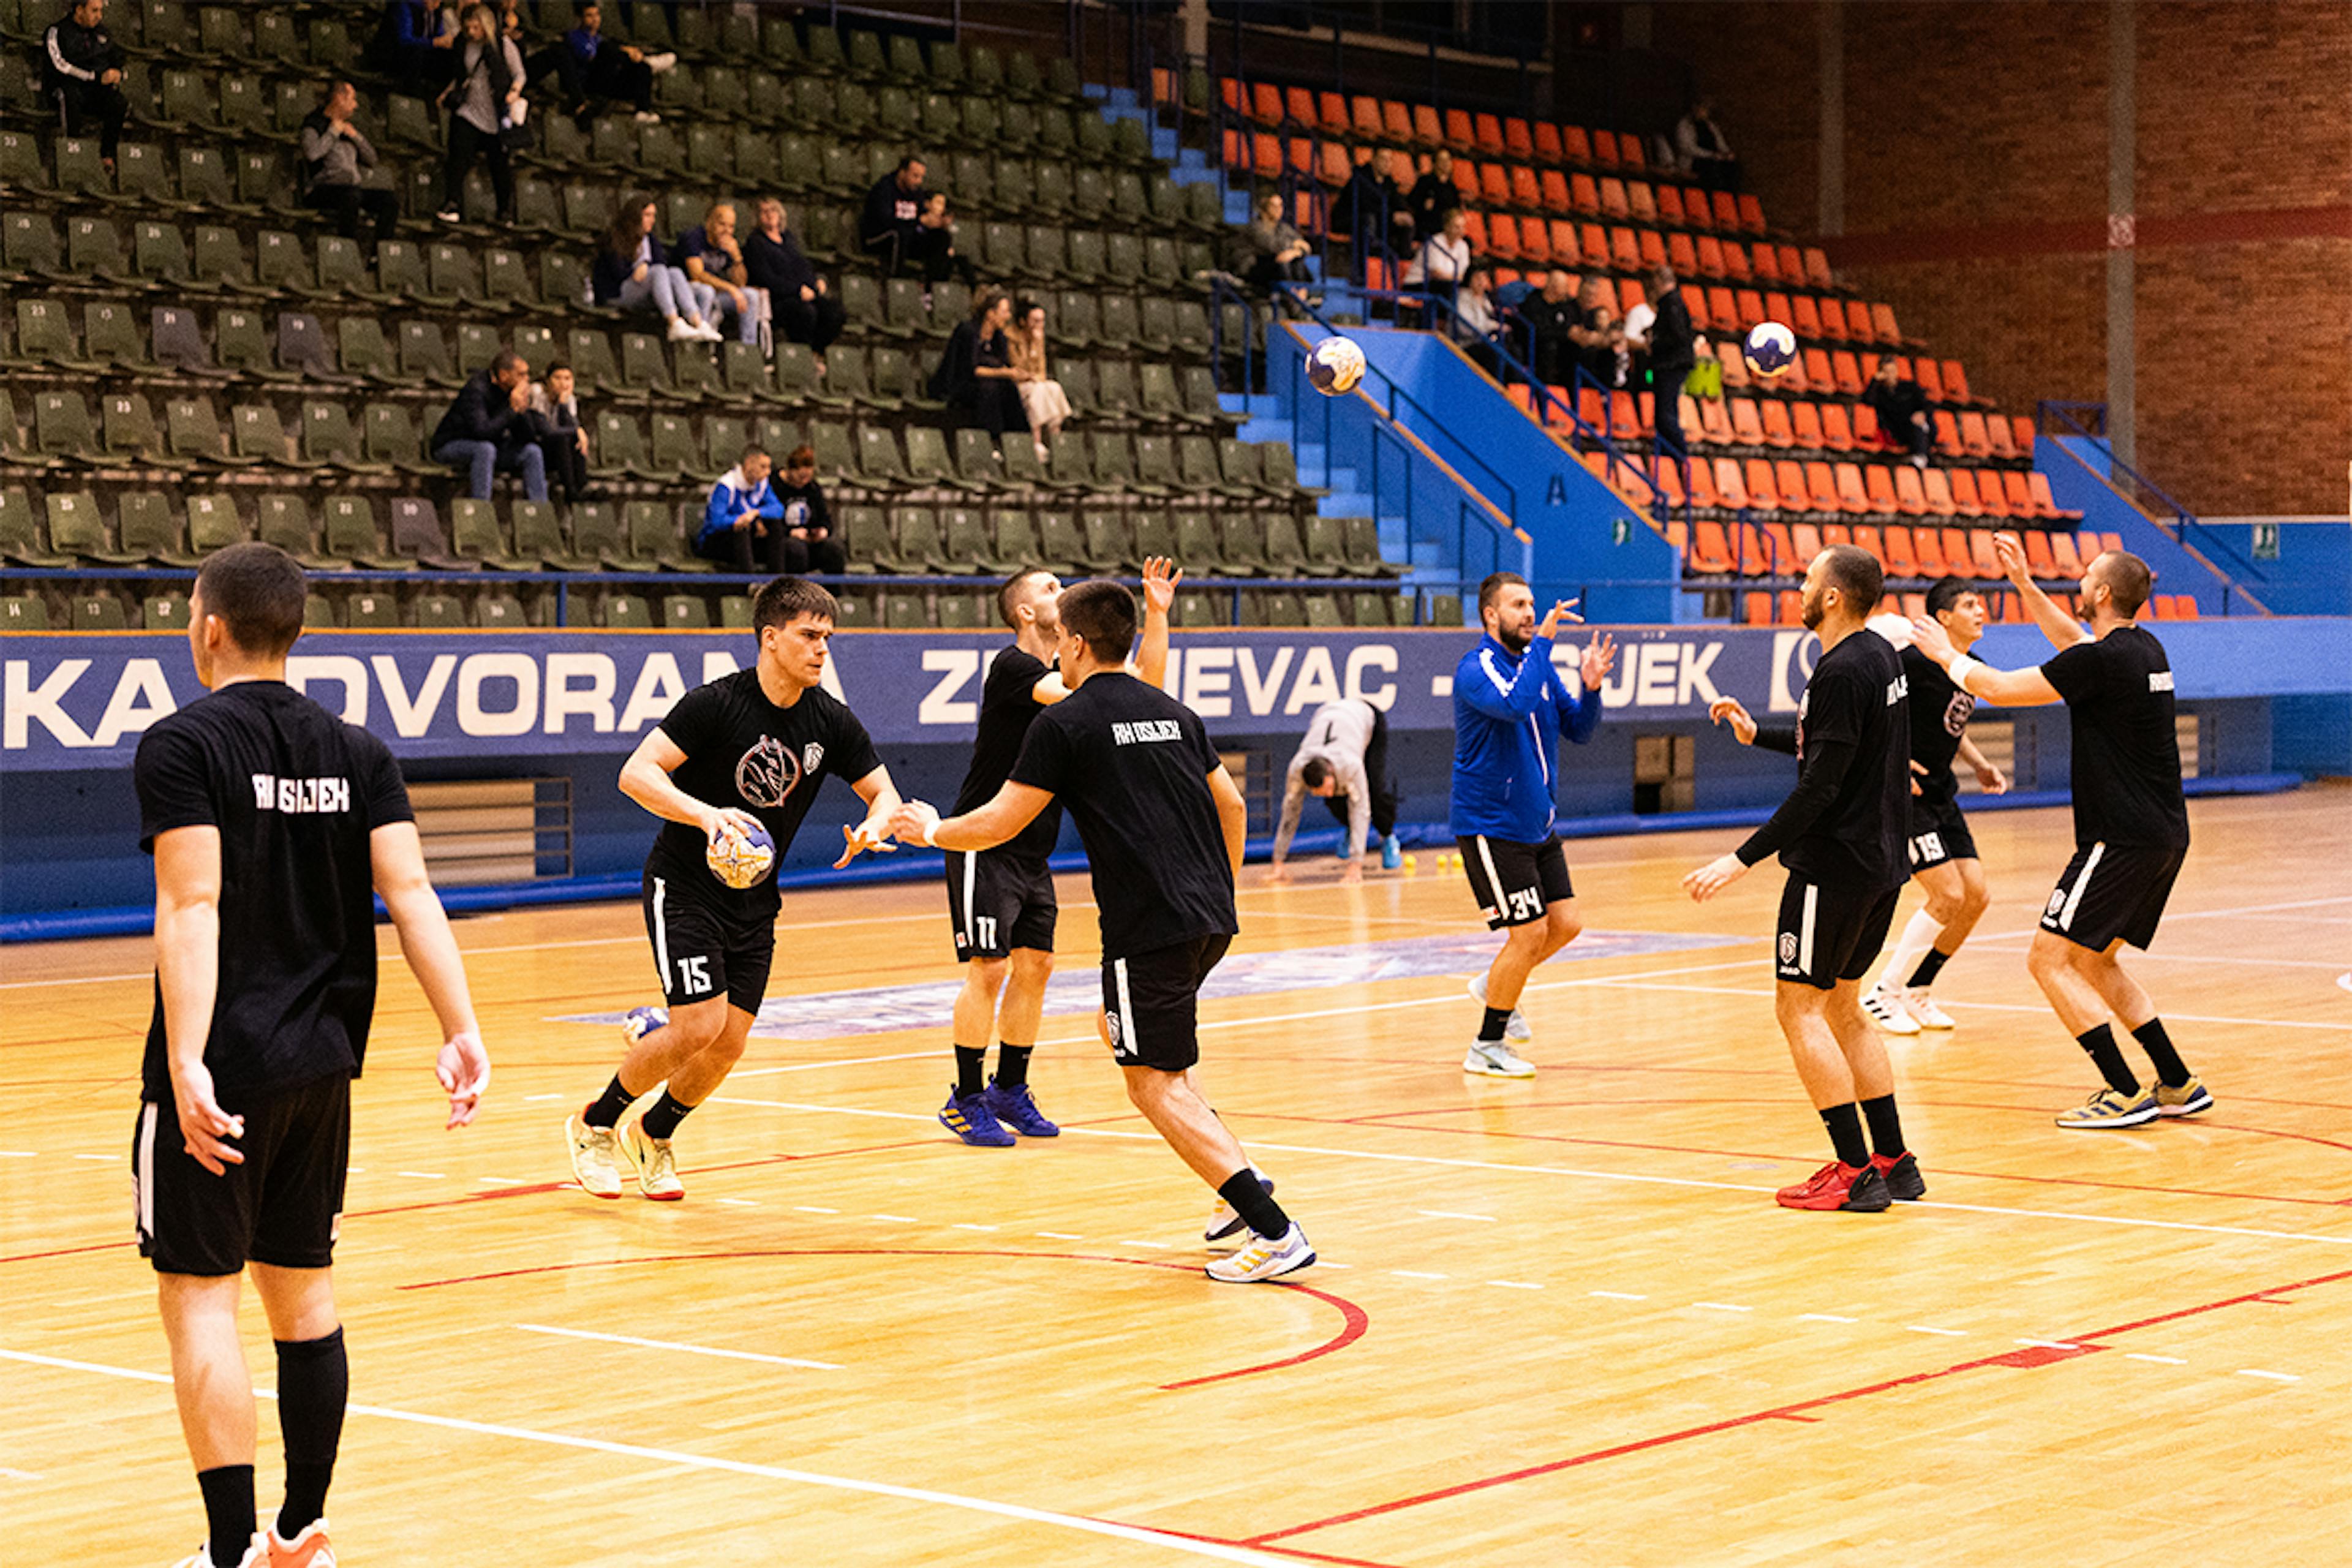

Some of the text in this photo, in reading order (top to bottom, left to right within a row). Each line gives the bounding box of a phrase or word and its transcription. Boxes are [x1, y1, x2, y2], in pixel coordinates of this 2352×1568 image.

[1547, 473, 1567, 505] A
[3, 658, 178, 749] KA
[285, 652, 848, 737] DVORA
[919, 644, 1398, 725] ZEVAC
[1915, 832, 1945, 862] 19
[1508, 886, 1544, 920] 34
[976, 916, 997, 949] 11
[677, 956, 712, 995] 15
